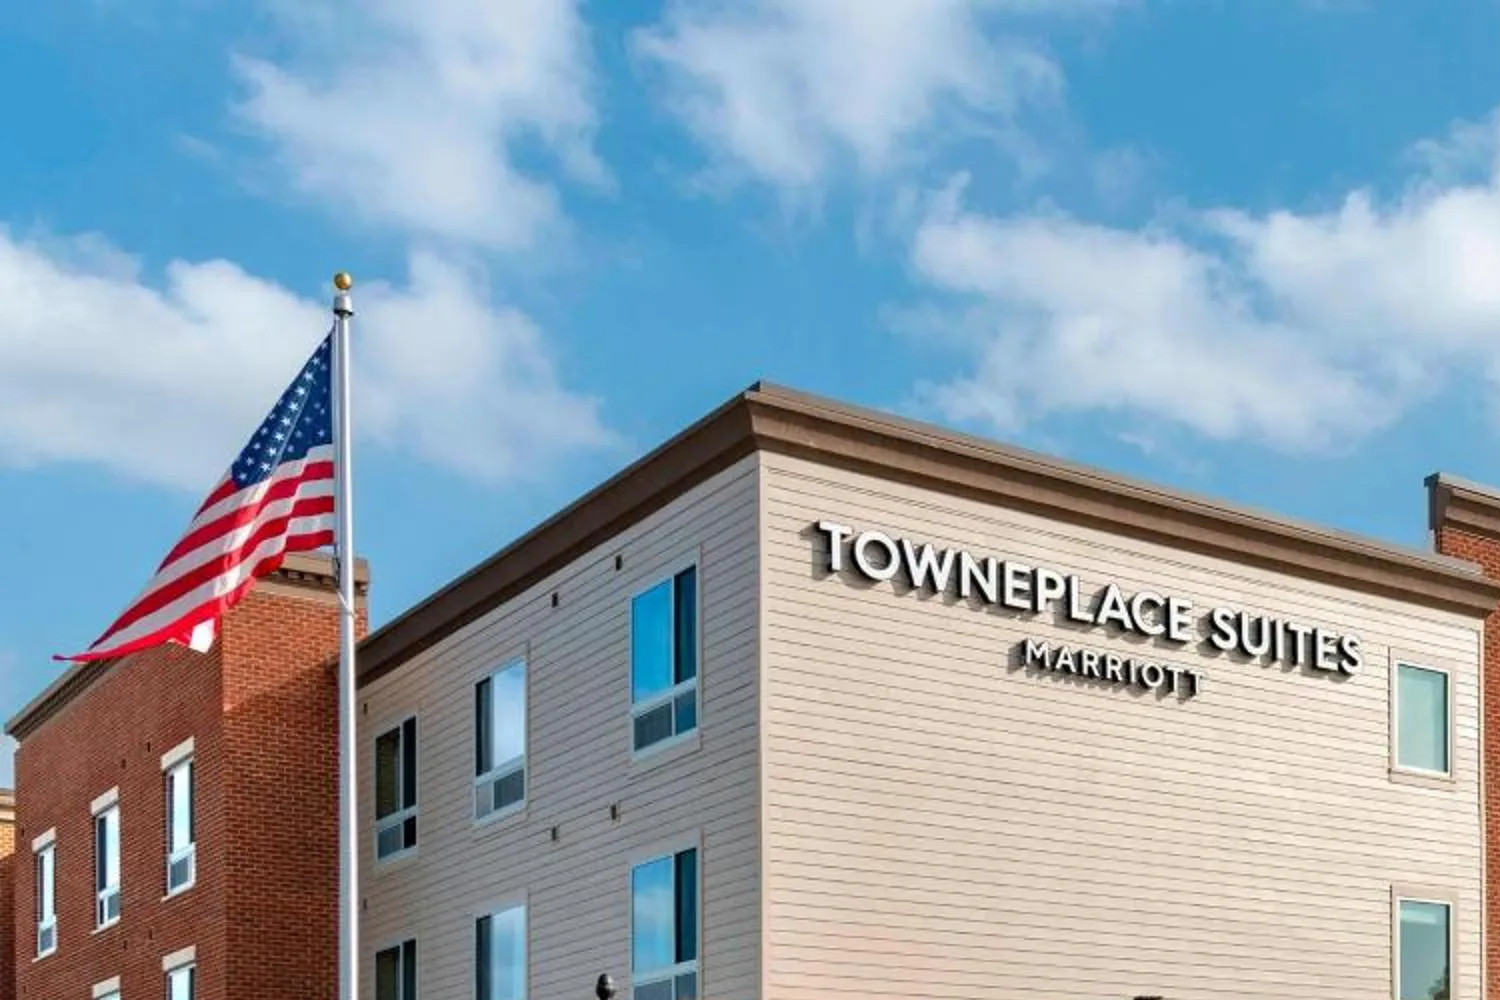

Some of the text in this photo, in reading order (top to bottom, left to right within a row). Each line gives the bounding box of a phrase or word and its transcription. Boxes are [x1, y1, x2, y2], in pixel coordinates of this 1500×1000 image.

[817, 520, 1364, 675] TOWNEPLACE SUITES
[1024, 637, 1207, 697] MARRIOTT
